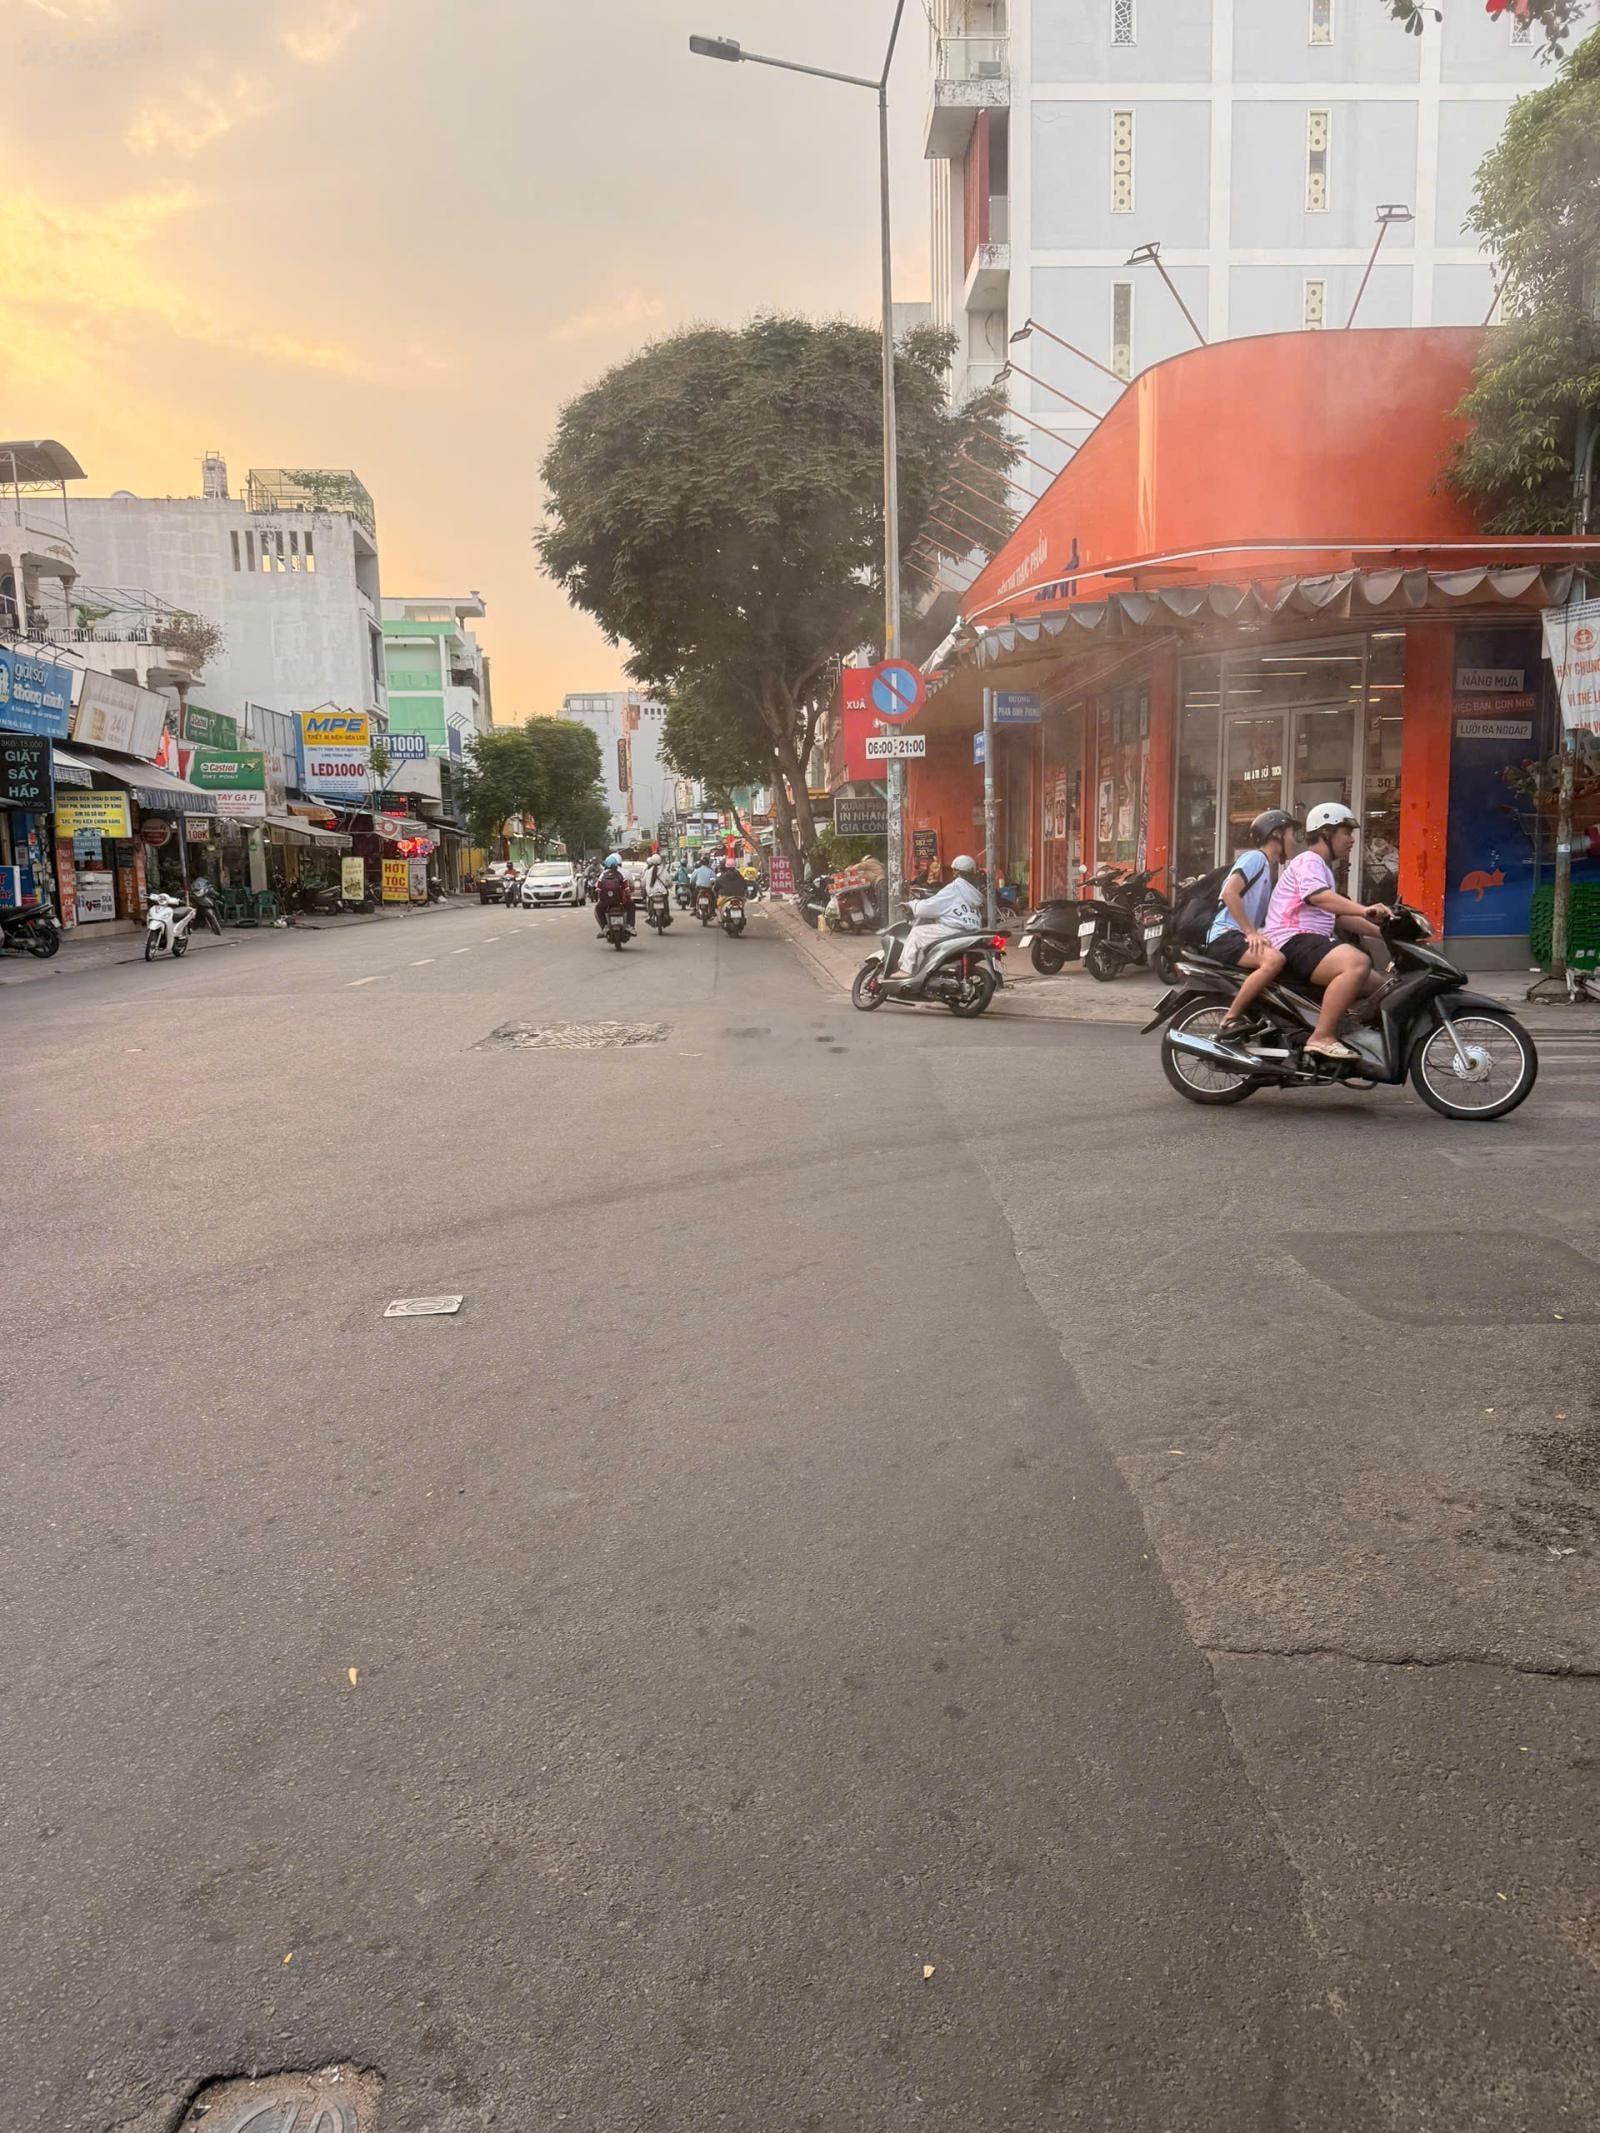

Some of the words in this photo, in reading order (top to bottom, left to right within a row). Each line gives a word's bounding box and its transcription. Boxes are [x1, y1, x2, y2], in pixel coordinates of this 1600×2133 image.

[306, 718, 365, 733] MPE
[1482, 725, 1495, 734] RA
[868, 741, 893, 755] 06:00
[898, 739, 925, 753] 21:00
[5, 748, 41, 764] GIẶT
[8, 764, 38, 780] SẤY
[209, 763, 236, 772] Castrol
[311, 763, 365, 777] LED1000
[9, 782, 40, 798] HẤP
[840, 812, 851, 821] IN
[841, 823, 860, 832] GIA
